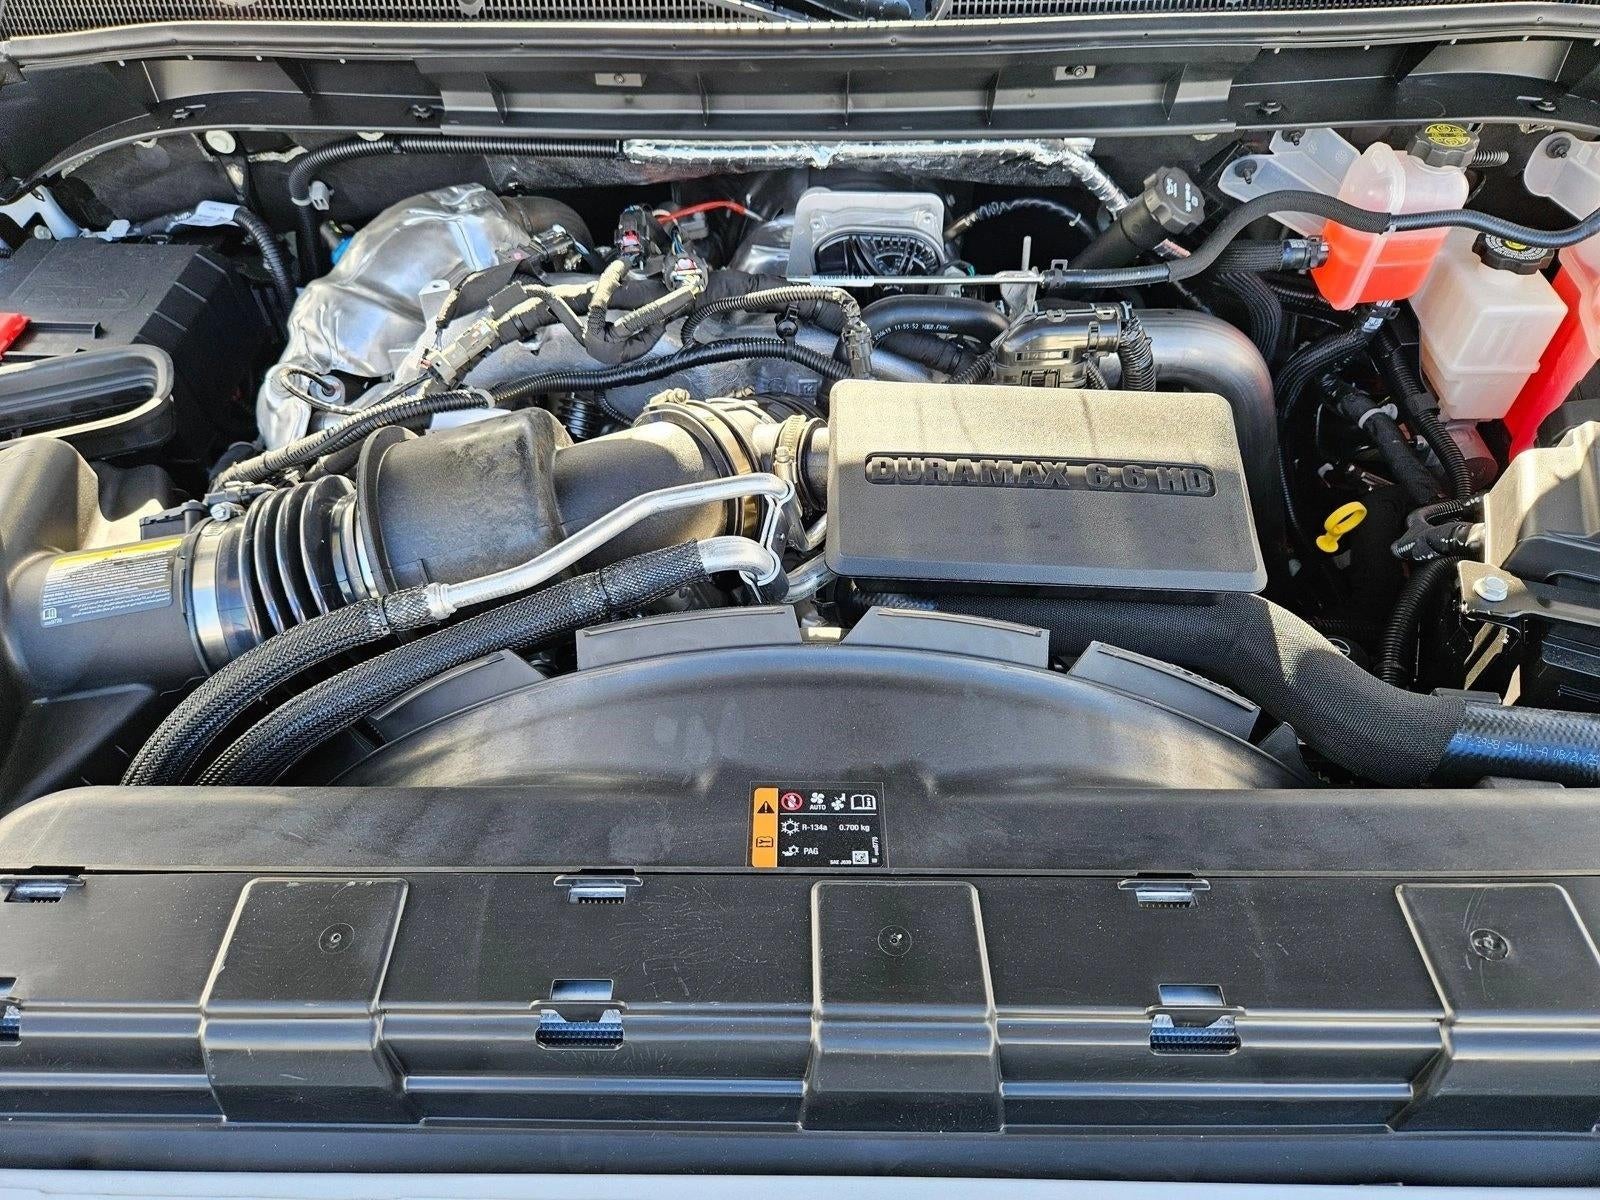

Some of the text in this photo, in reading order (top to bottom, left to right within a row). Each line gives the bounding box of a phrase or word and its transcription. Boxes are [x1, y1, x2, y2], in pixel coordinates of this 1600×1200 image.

[871, 456, 1212, 493] DURAMAX 6.6 HD
[801, 823, 871, 833] R-134a 0.700 kg
[803, 847, 819, 856] PAG
